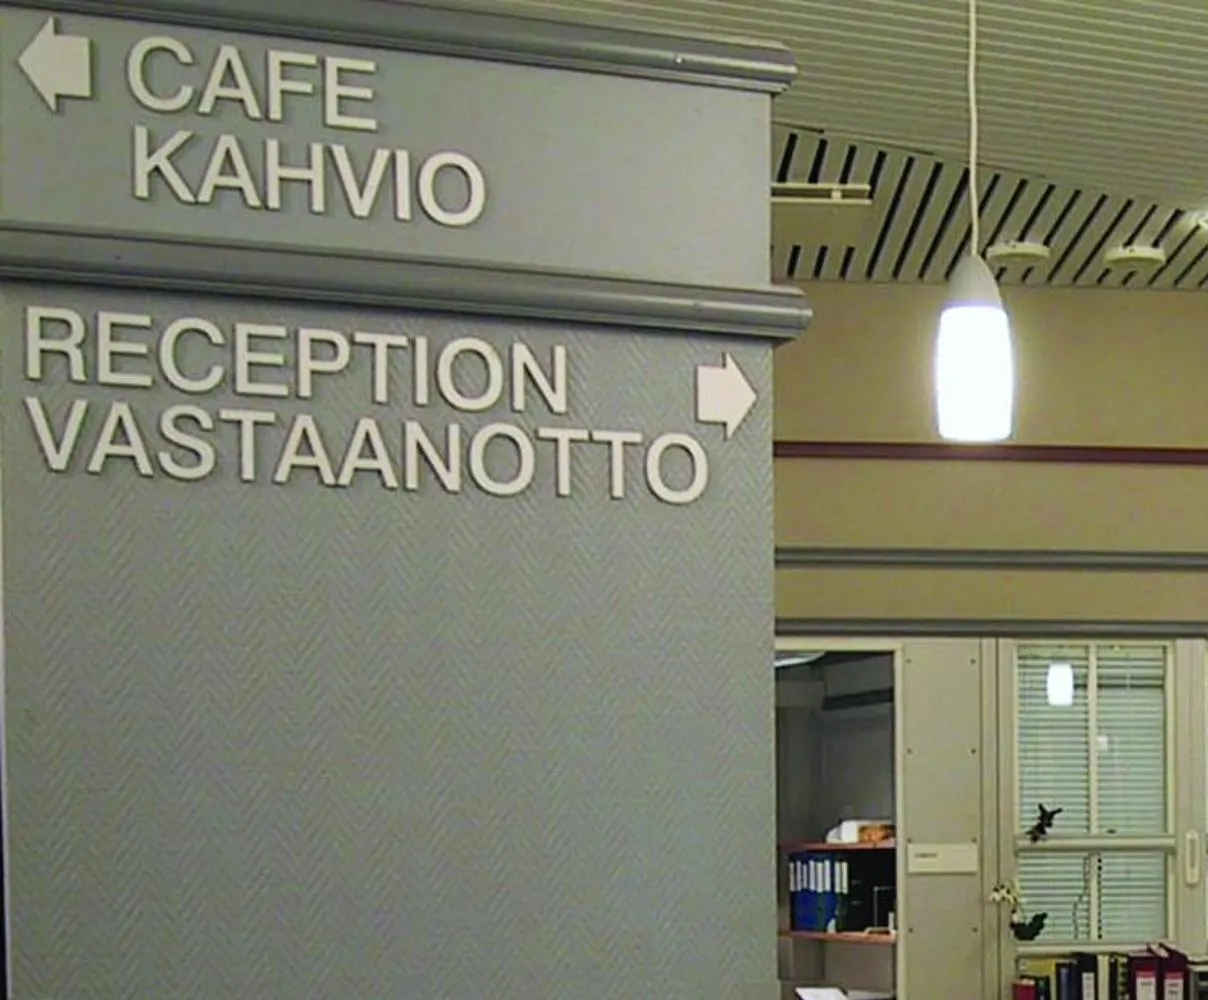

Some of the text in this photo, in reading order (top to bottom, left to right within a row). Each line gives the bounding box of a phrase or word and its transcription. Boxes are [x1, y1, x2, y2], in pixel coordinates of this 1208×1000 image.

[127, 37, 378, 131] CAFE
[133, 124, 486, 226] KAHVIO
[26, 306, 567, 414] RECEPTION
[25, 397, 709, 504] VASTAANOTTO
